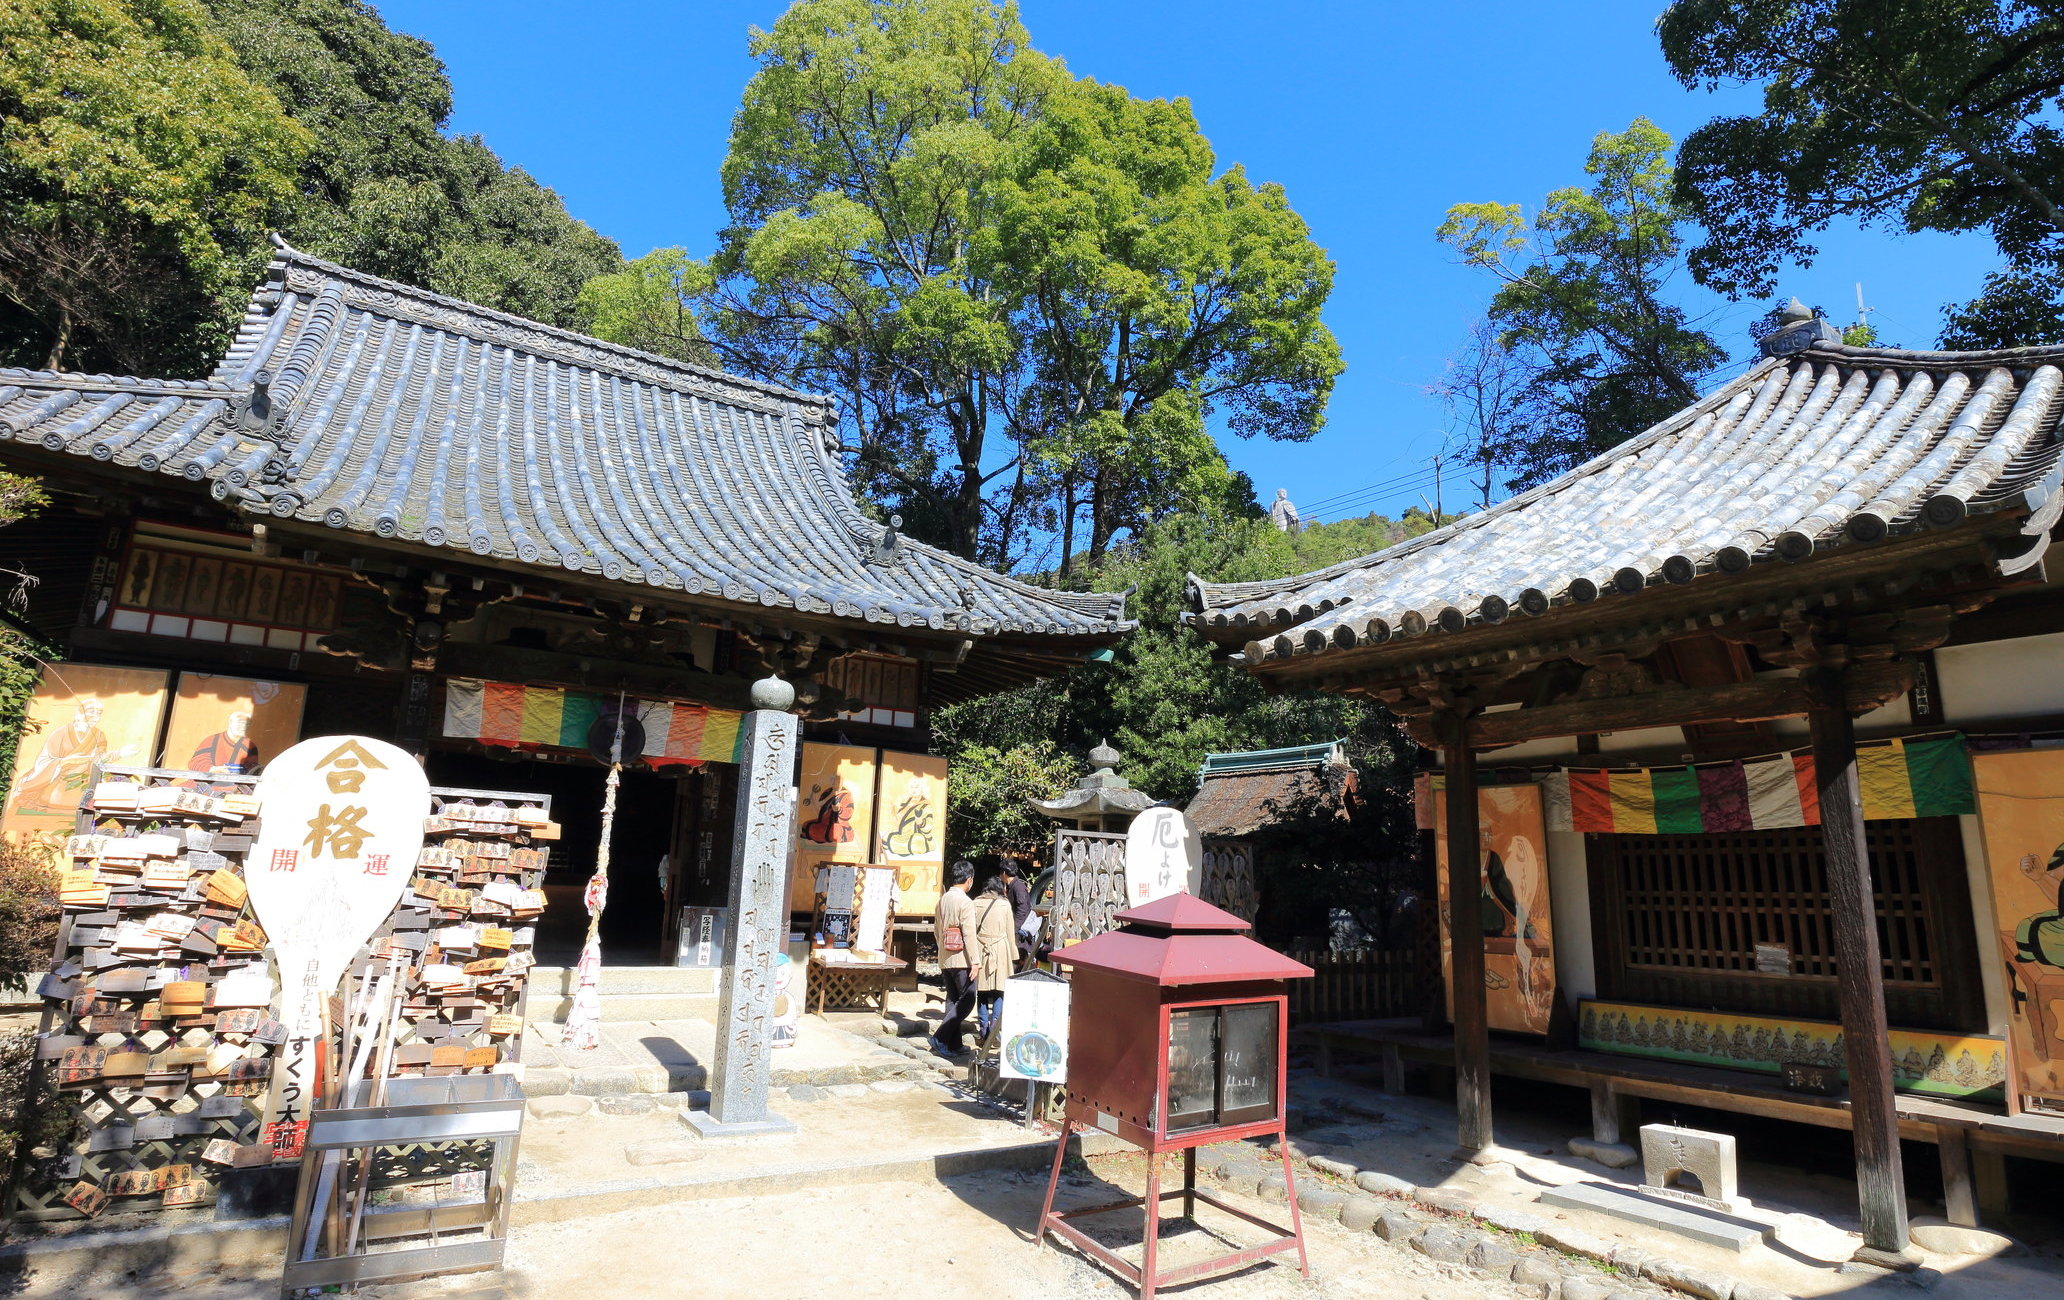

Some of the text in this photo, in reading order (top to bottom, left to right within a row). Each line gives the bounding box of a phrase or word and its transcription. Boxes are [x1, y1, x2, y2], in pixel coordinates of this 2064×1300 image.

[303, 738, 389, 860] 合格
[269, 848, 391, 876] 開 運
[1152, 812, 1179, 889] 厄よけ
[1138, 882, 1150, 899] 開
[296, 958, 319, 1031] 自他ともに
[272, 1035, 310, 1151] すくう大師
